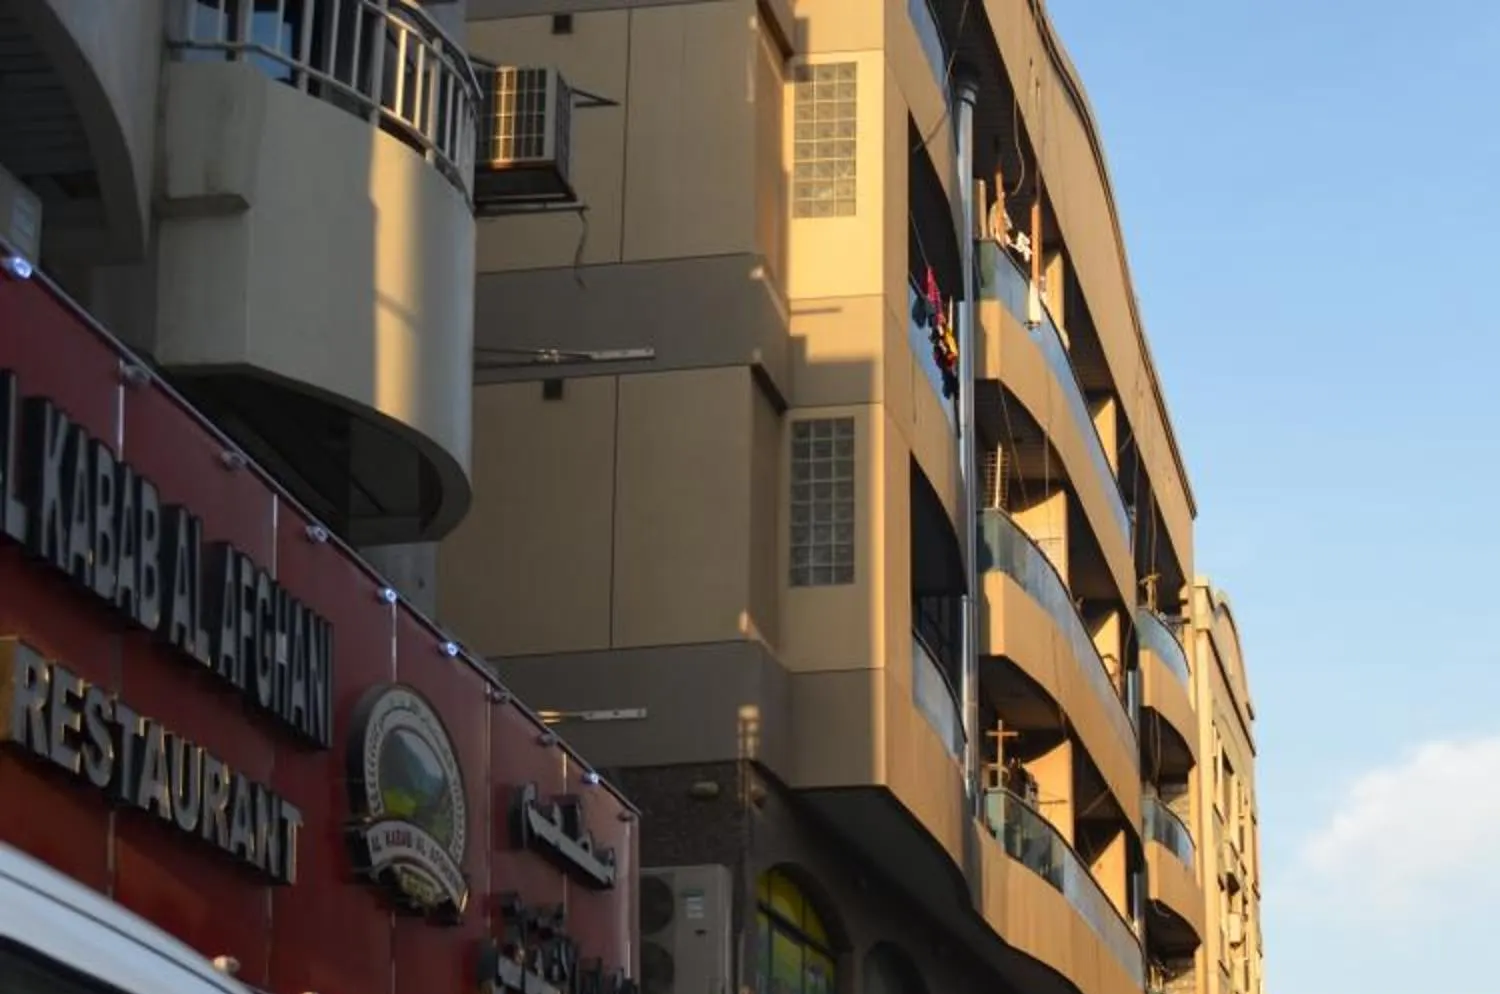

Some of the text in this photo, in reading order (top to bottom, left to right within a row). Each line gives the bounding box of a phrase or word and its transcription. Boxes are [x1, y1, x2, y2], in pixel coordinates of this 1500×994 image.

[0, 373, 333, 748] L KABAB AL AFGHANI
[11, 637, 304, 886] RESTAURANT
